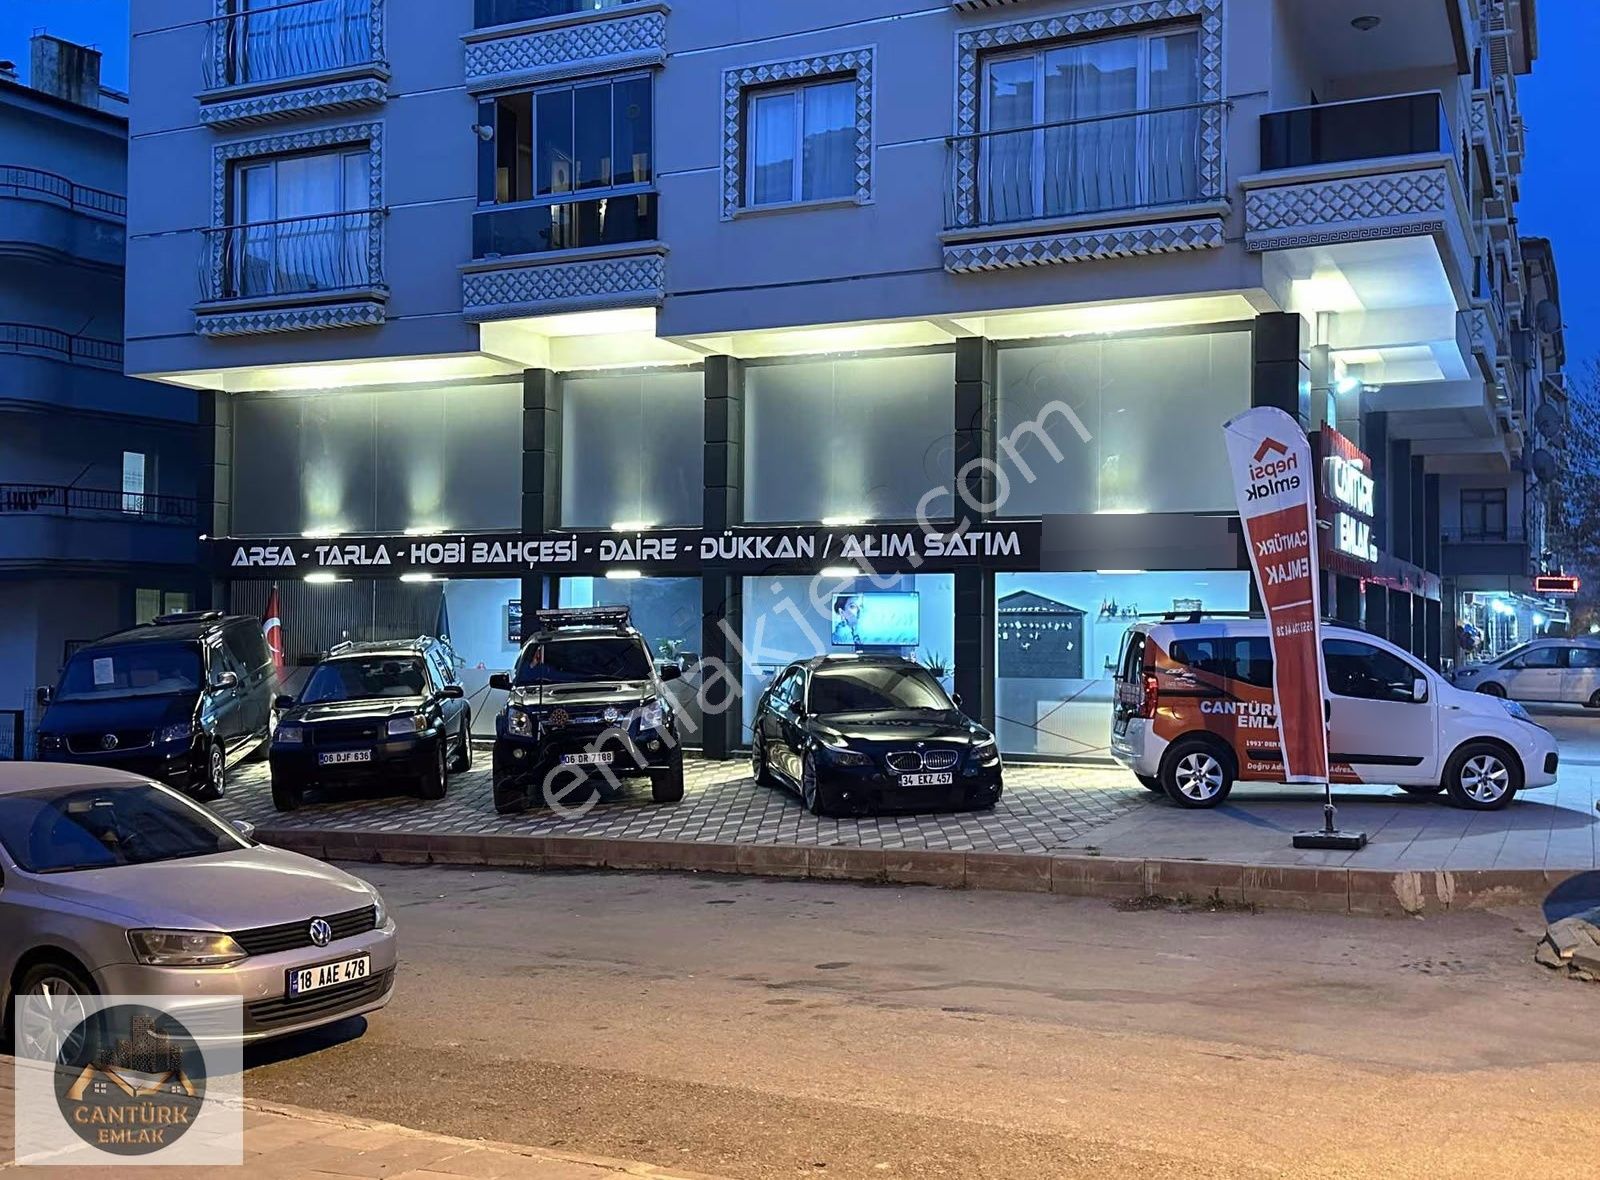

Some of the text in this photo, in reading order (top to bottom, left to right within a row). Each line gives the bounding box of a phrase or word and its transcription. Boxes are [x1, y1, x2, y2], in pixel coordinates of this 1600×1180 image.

[231, 544, 296, 567] ARSA
[315, 543, 391, 565] TARLA
[411, 537, 465, 564] HOBİ
[472, 534, 577, 569] BAHÇESİ
[599, 532, 677, 561] DAİRE
[700, 530, 814, 560] DÜKKAN
[841, 532, 915, 558] ALIM
[924, 531, 1021, 557] SATIM
[903, 773, 951, 786] 34 EKZ 457
[300, 971, 312, 990] 18
[318, 965, 340, 986] AAE
[345, 959, 365, 979] 478
